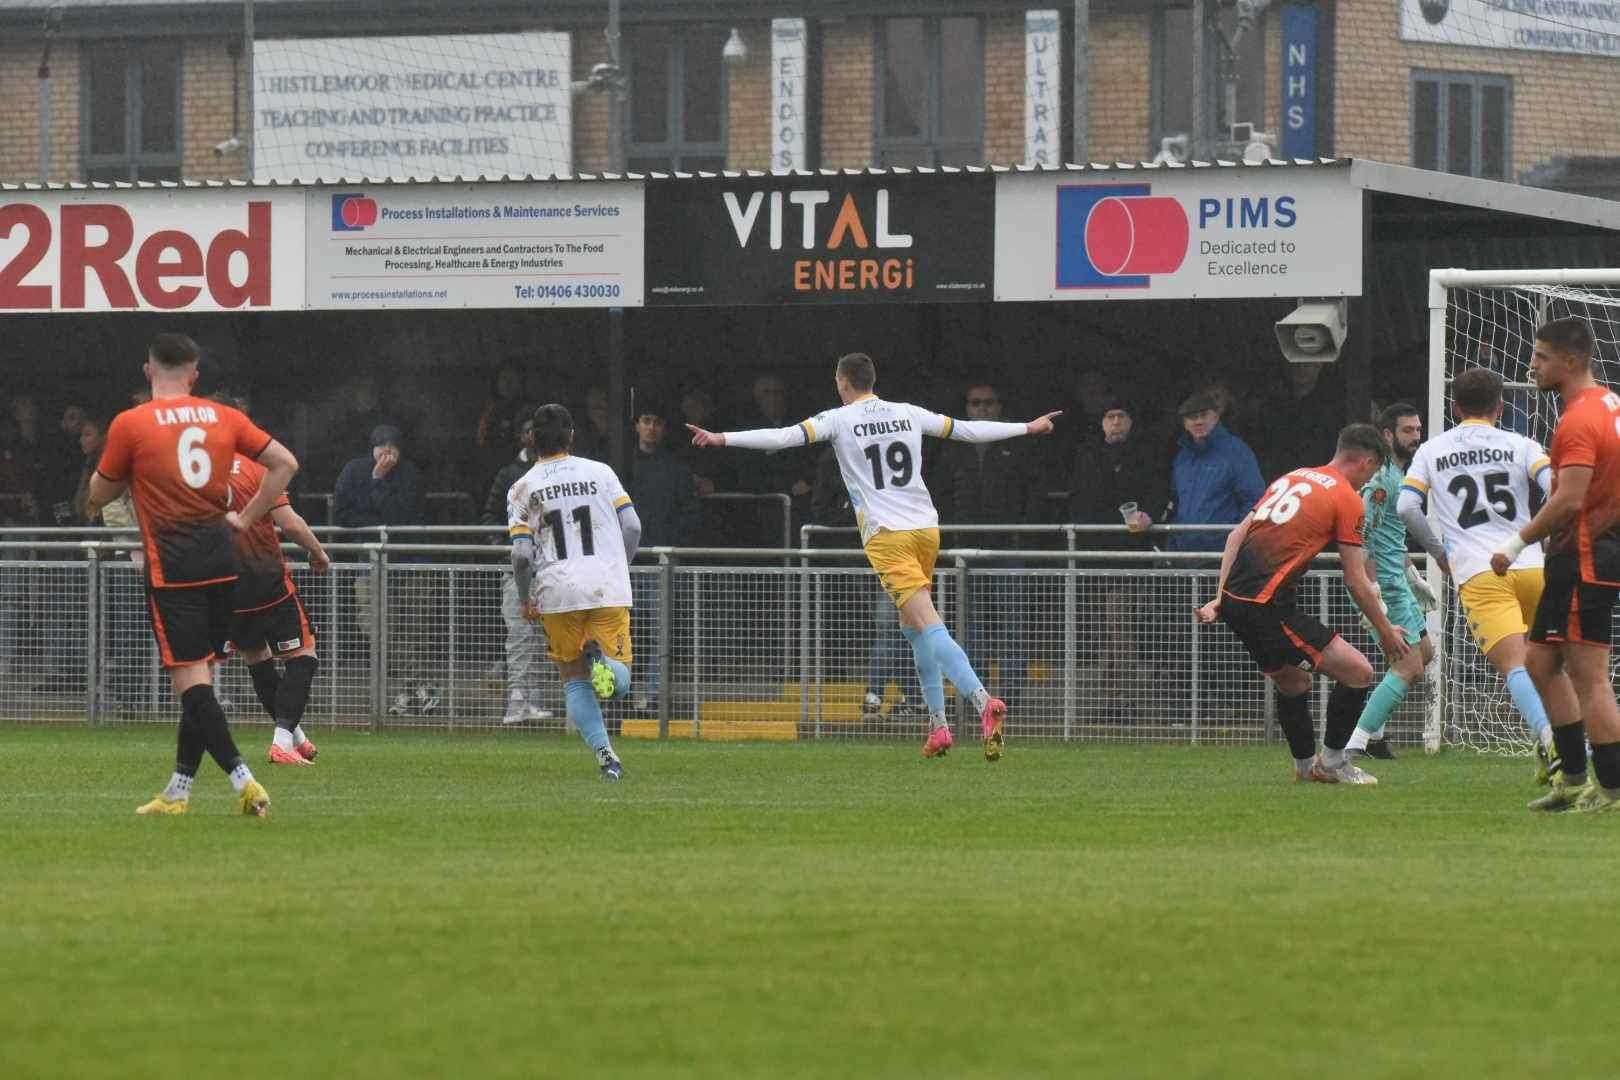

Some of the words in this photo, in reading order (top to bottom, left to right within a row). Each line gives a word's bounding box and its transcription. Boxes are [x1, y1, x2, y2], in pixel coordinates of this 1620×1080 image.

[260, 73, 390, 93] THISTLEMOOR
[485, 68, 560, 88] CENTRE
[1288, 43, 1306, 129] NHS
[261, 107, 346, 128] TEACHING
[350, 106, 386, 126] AND
[389, 105, 471, 124] TRAINING
[474, 103, 557, 122] PRACTICE
[305, 139, 417, 158] CONFERENCE
[420, 136, 509, 156] FACILITIES
[381, 206, 423, 220] Process
[425, 206, 491, 219] Installations
[493, 205, 502, 218] &
[503, 205, 572, 218] Maintenance
[574, 204, 620, 217] Services
[722, 189, 913, 250] VITAL
[1200, 196, 1297, 229] PIMS
[345, 246, 393, 256] Mechanical
[394, 246, 401, 255] &
[403, 246, 441, 255] Electrical
[443, 245, 484, 257] Engineers
[486, 244, 501, 254] and
[503, 244, 552, 254] Contractors
[555, 244, 564, 253] To
[566, 243, 582, 253] The
[583, 243, 604, 253] Food
[1200, 240, 1276, 254] Dedicated
[1281, 240, 1296, 254] to
[435, 259, 480, 269] Healthcare
[482, 259, 489, 268] &
[490, 259, 519, 270] Energy
[521, 258, 563, 268] Industries
[1208, 261, 1288, 276] Excellence
[331, 289, 448, 300] www.processinstallations.net
[515, 285, 535, 298] Tel:
[537, 285, 572, 298] 01406
[574, 284, 620, 298] 430030
[154, 406, 219, 425] LAWLOR
[853, 419, 912, 437] CYBULSKI
[178, 426, 212, 489] 6
[864, 441, 913, 490] 19
[1436, 448, 1514, 472] MORRISON
[531, 481, 598, 505] STEPHENS
[1252, 478, 1312, 525] 26
[1448, 472, 1517, 530] 25
[543, 505, 595, 561] 11
